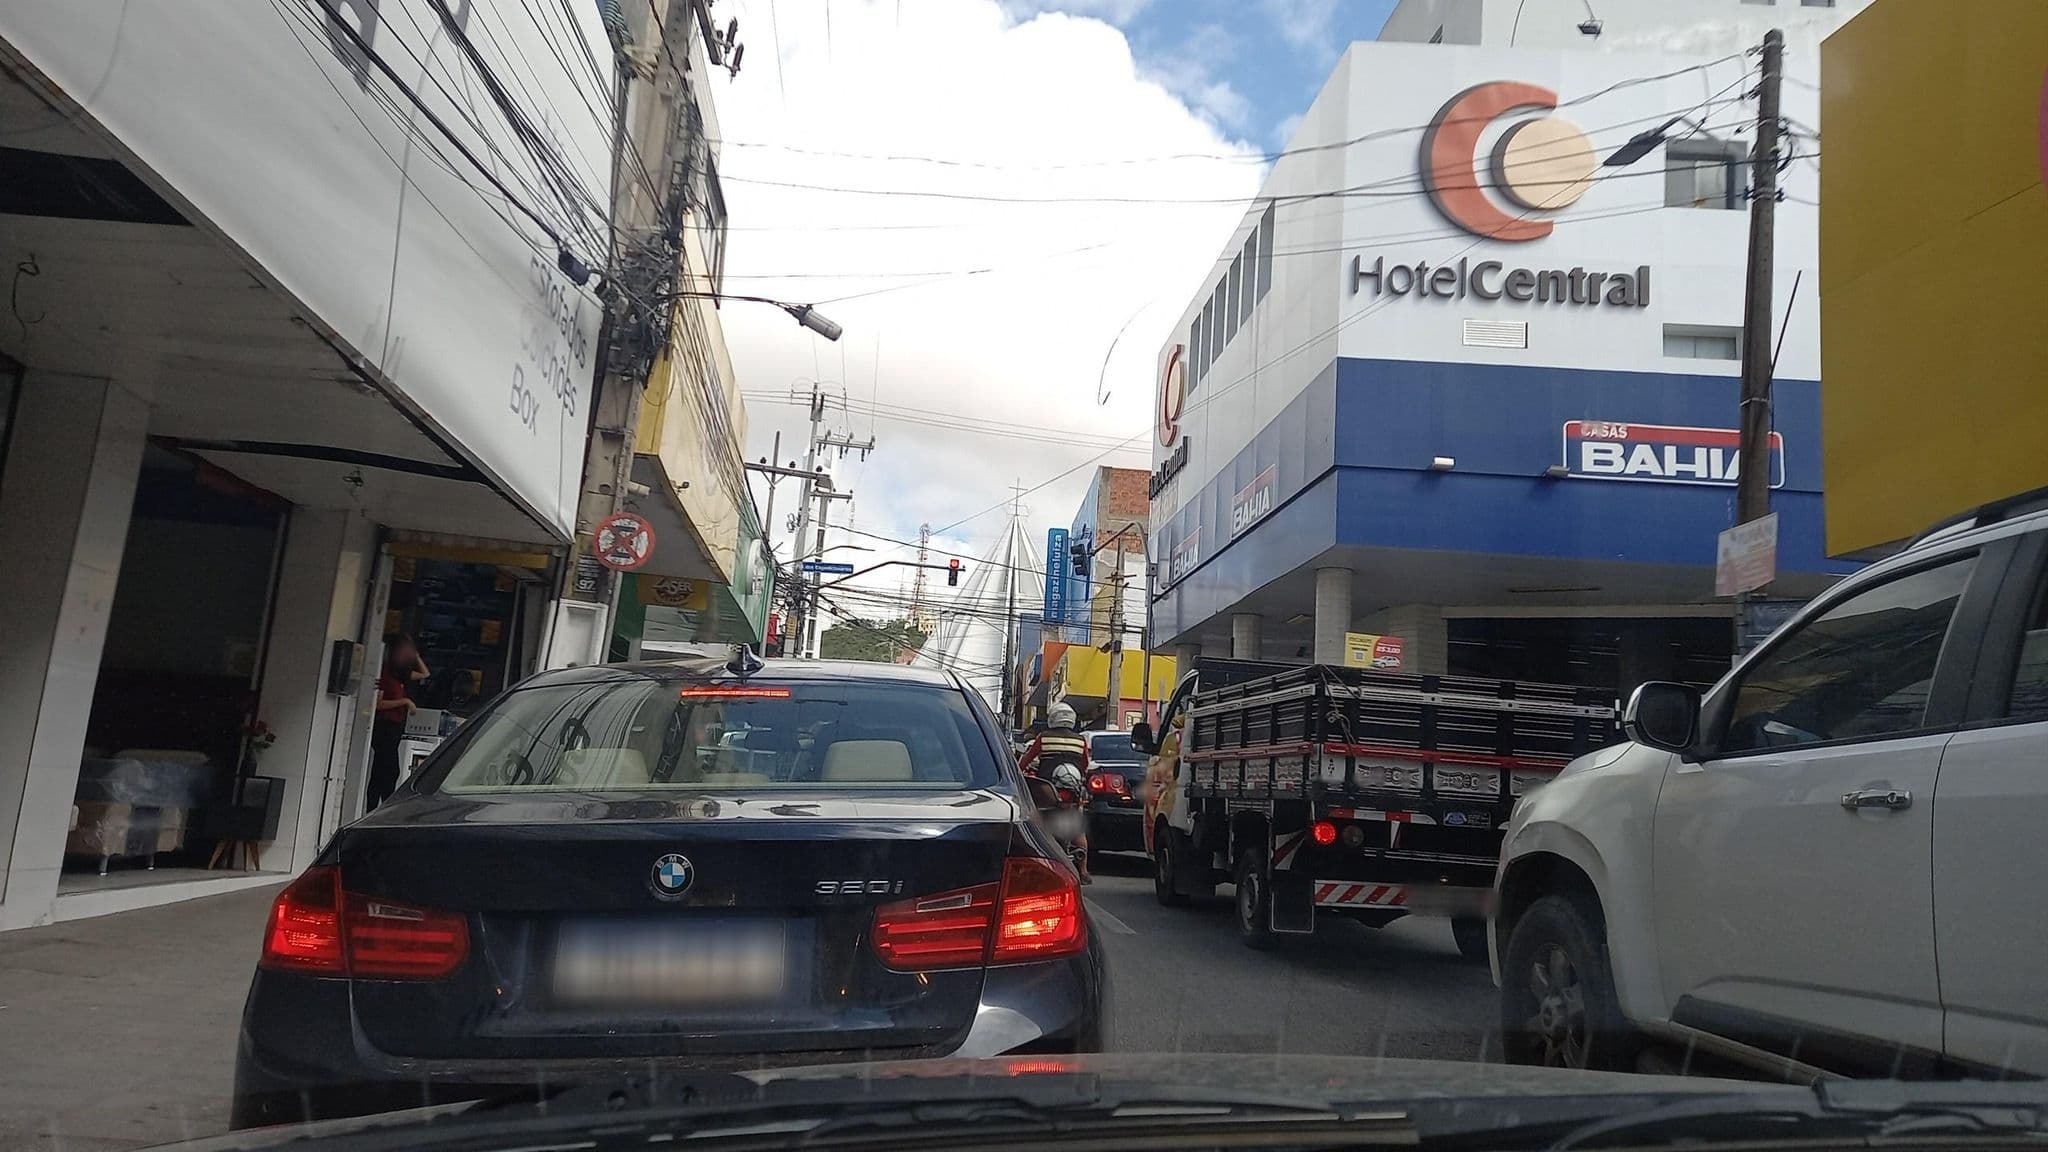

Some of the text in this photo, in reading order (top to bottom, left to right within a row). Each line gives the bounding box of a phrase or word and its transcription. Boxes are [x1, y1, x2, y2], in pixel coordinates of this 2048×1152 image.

[1352, 254, 1651, 307] HotelCentral
[511, 363, 540, 436] Box
[1233, 486, 1270, 534] BAHIA
[656, 855, 691, 869] BMW
[815, 880, 904, 894] 320i
